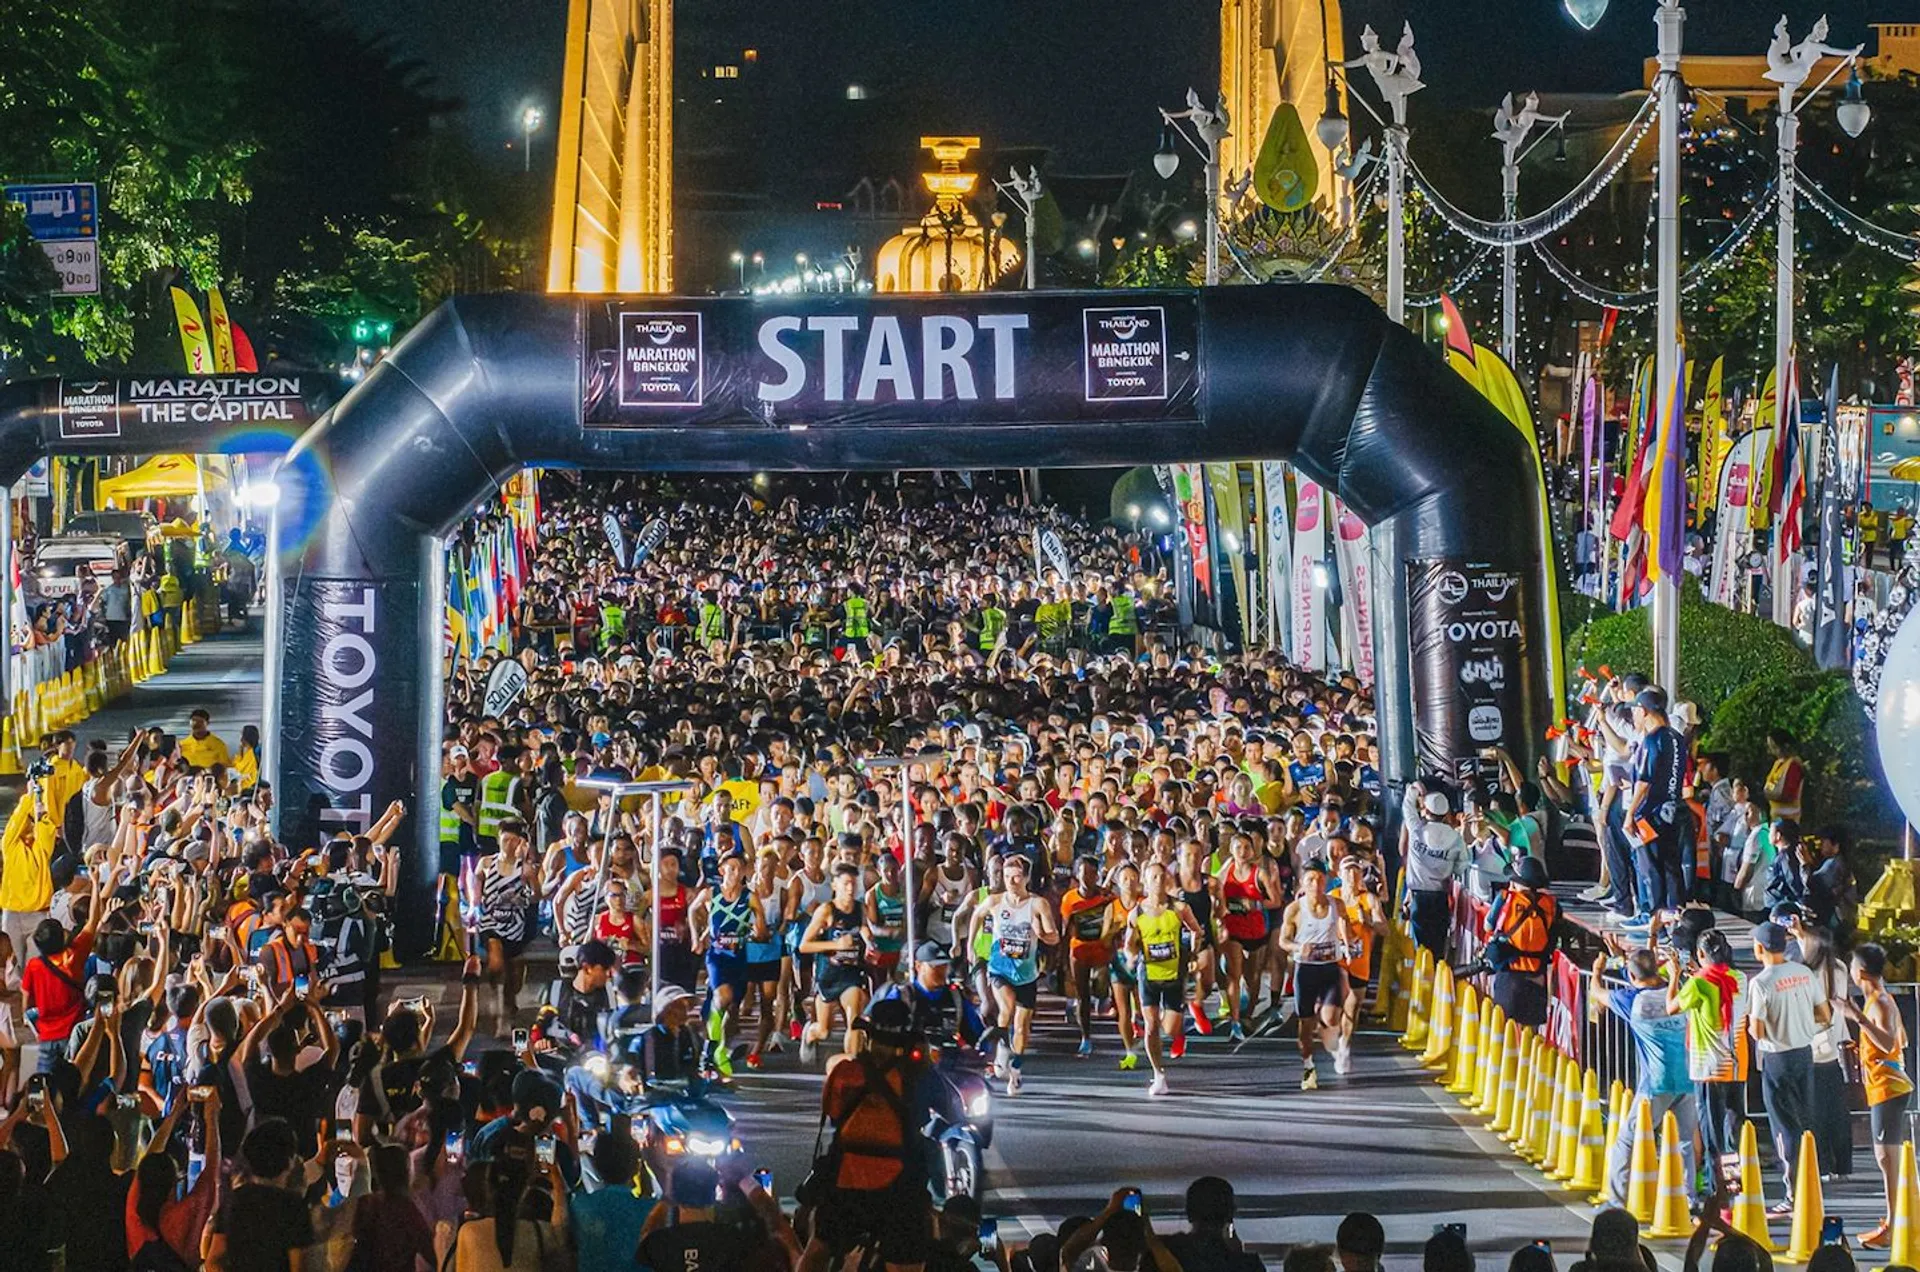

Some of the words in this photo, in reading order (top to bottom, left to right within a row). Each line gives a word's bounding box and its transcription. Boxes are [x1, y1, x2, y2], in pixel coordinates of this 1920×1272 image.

[636, 324, 687, 333] THAILAND
[1099, 319, 1150, 329] THAILAND
[627, 347, 696, 361] MARATHON
[1091, 342, 1160, 357] MARATHON
[757, 314, 1029, 401] START
[1098, 356, 1153, 368] BANGKOK
[633, 361, 689, 372] BANGKOK
[130, 377, 300, 397] MARATHON
[641, 382, 681, 392] TOYOTA
[1107, 377, 1146, 387] TOYOTA
[64, 394, 114, 406] MARATHON
[139, 402, 187, 424] THE
[190, 399, 294, 423] CAPITAL
[75, 420, 104, 428] TOYOTA
[1439, 620, 1522, 640] TOYOTA
[320, 588, 377, 846] TOYOT
